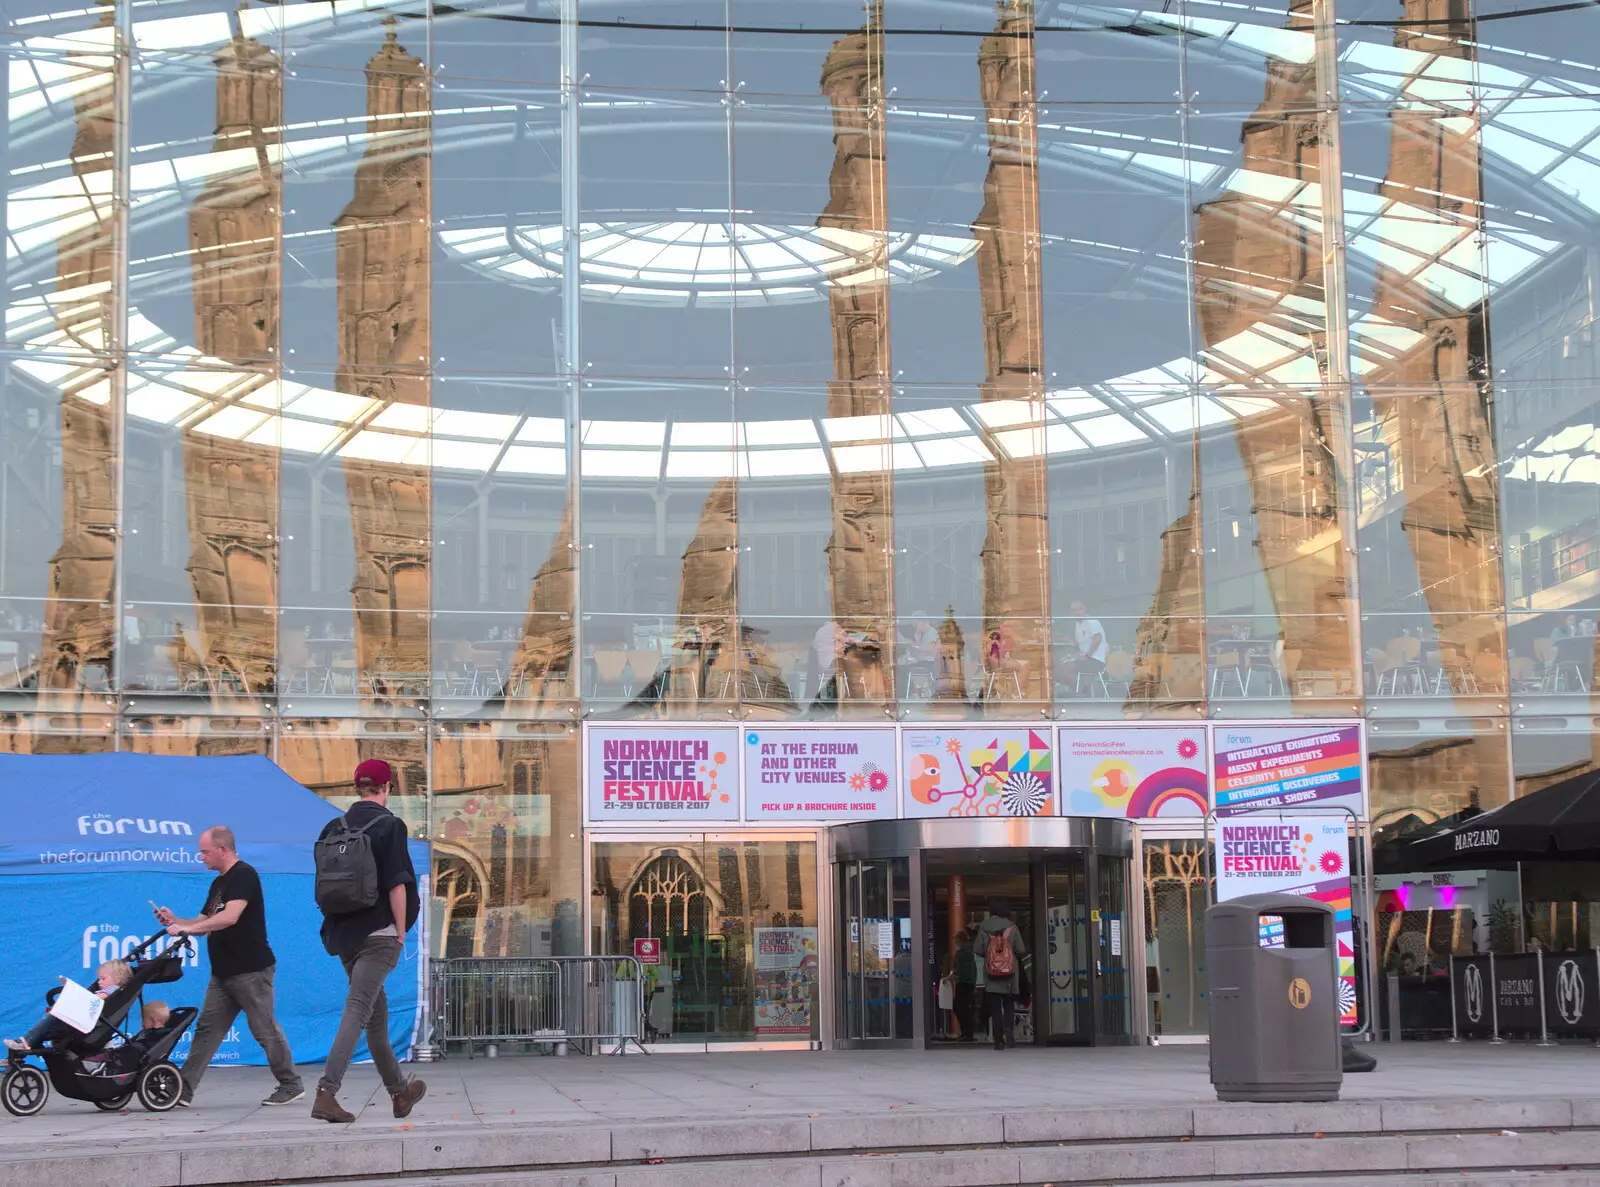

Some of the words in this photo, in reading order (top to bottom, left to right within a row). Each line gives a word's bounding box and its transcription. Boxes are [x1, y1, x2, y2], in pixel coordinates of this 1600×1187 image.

[603, 740, 709, 760] NORWICH
[761, 743, 777, 755] AT
[782, 743, 807, 755] THE
[811, 743, 859, 755] FORUM
[1226, 743, 1284, 761] INTERACTIVE
[1286, 733, 1341, 750] EXHIBITIONS
[603, 760, 696, 780] SCIENCE
[761, 757, 789, 769] AND
[793, 757, 837, 769] OTHER
[1227, 762, 1258, 775] MESSY
[1260, 750, 1323, 769] EXPERIMENTS
[761, 771, 791, 783] CITY
[795, 771, 846, 783] VENUES
[1228, 771, 1276, 788] CELEBRITY
[1278, 766, 1306, 778] TALKS
[603, 781, 710, 801] FESTIVAL
[1228, 783, 1280, 801] INTRIGUING
[1282, 772, 1340, 790] DISCOVERIES
[1284, 790, 1317, 804] SHOWS
[636, 801, 684, 810] OCTOBER
[686, 801, 710, 810] 2017
[762, 803, 780, 811] PICK
[783, 803, 795, 811] UP
[797, 803, 802, 811] A
[805, 803, 848, 811] BROCHURE
[850, 802, 877, 811] INSIDE
[1223, 826, 1300, 841] NORWICH
[1455, 829, 1500, 851] MARZANO
[1224, 841, 1291, 856] SCIENCE
[1224, 856, 1301, 871] FESTIVAL
[100, 923, 119, 932] the
[212, 1051, 240, 1059] orwich
